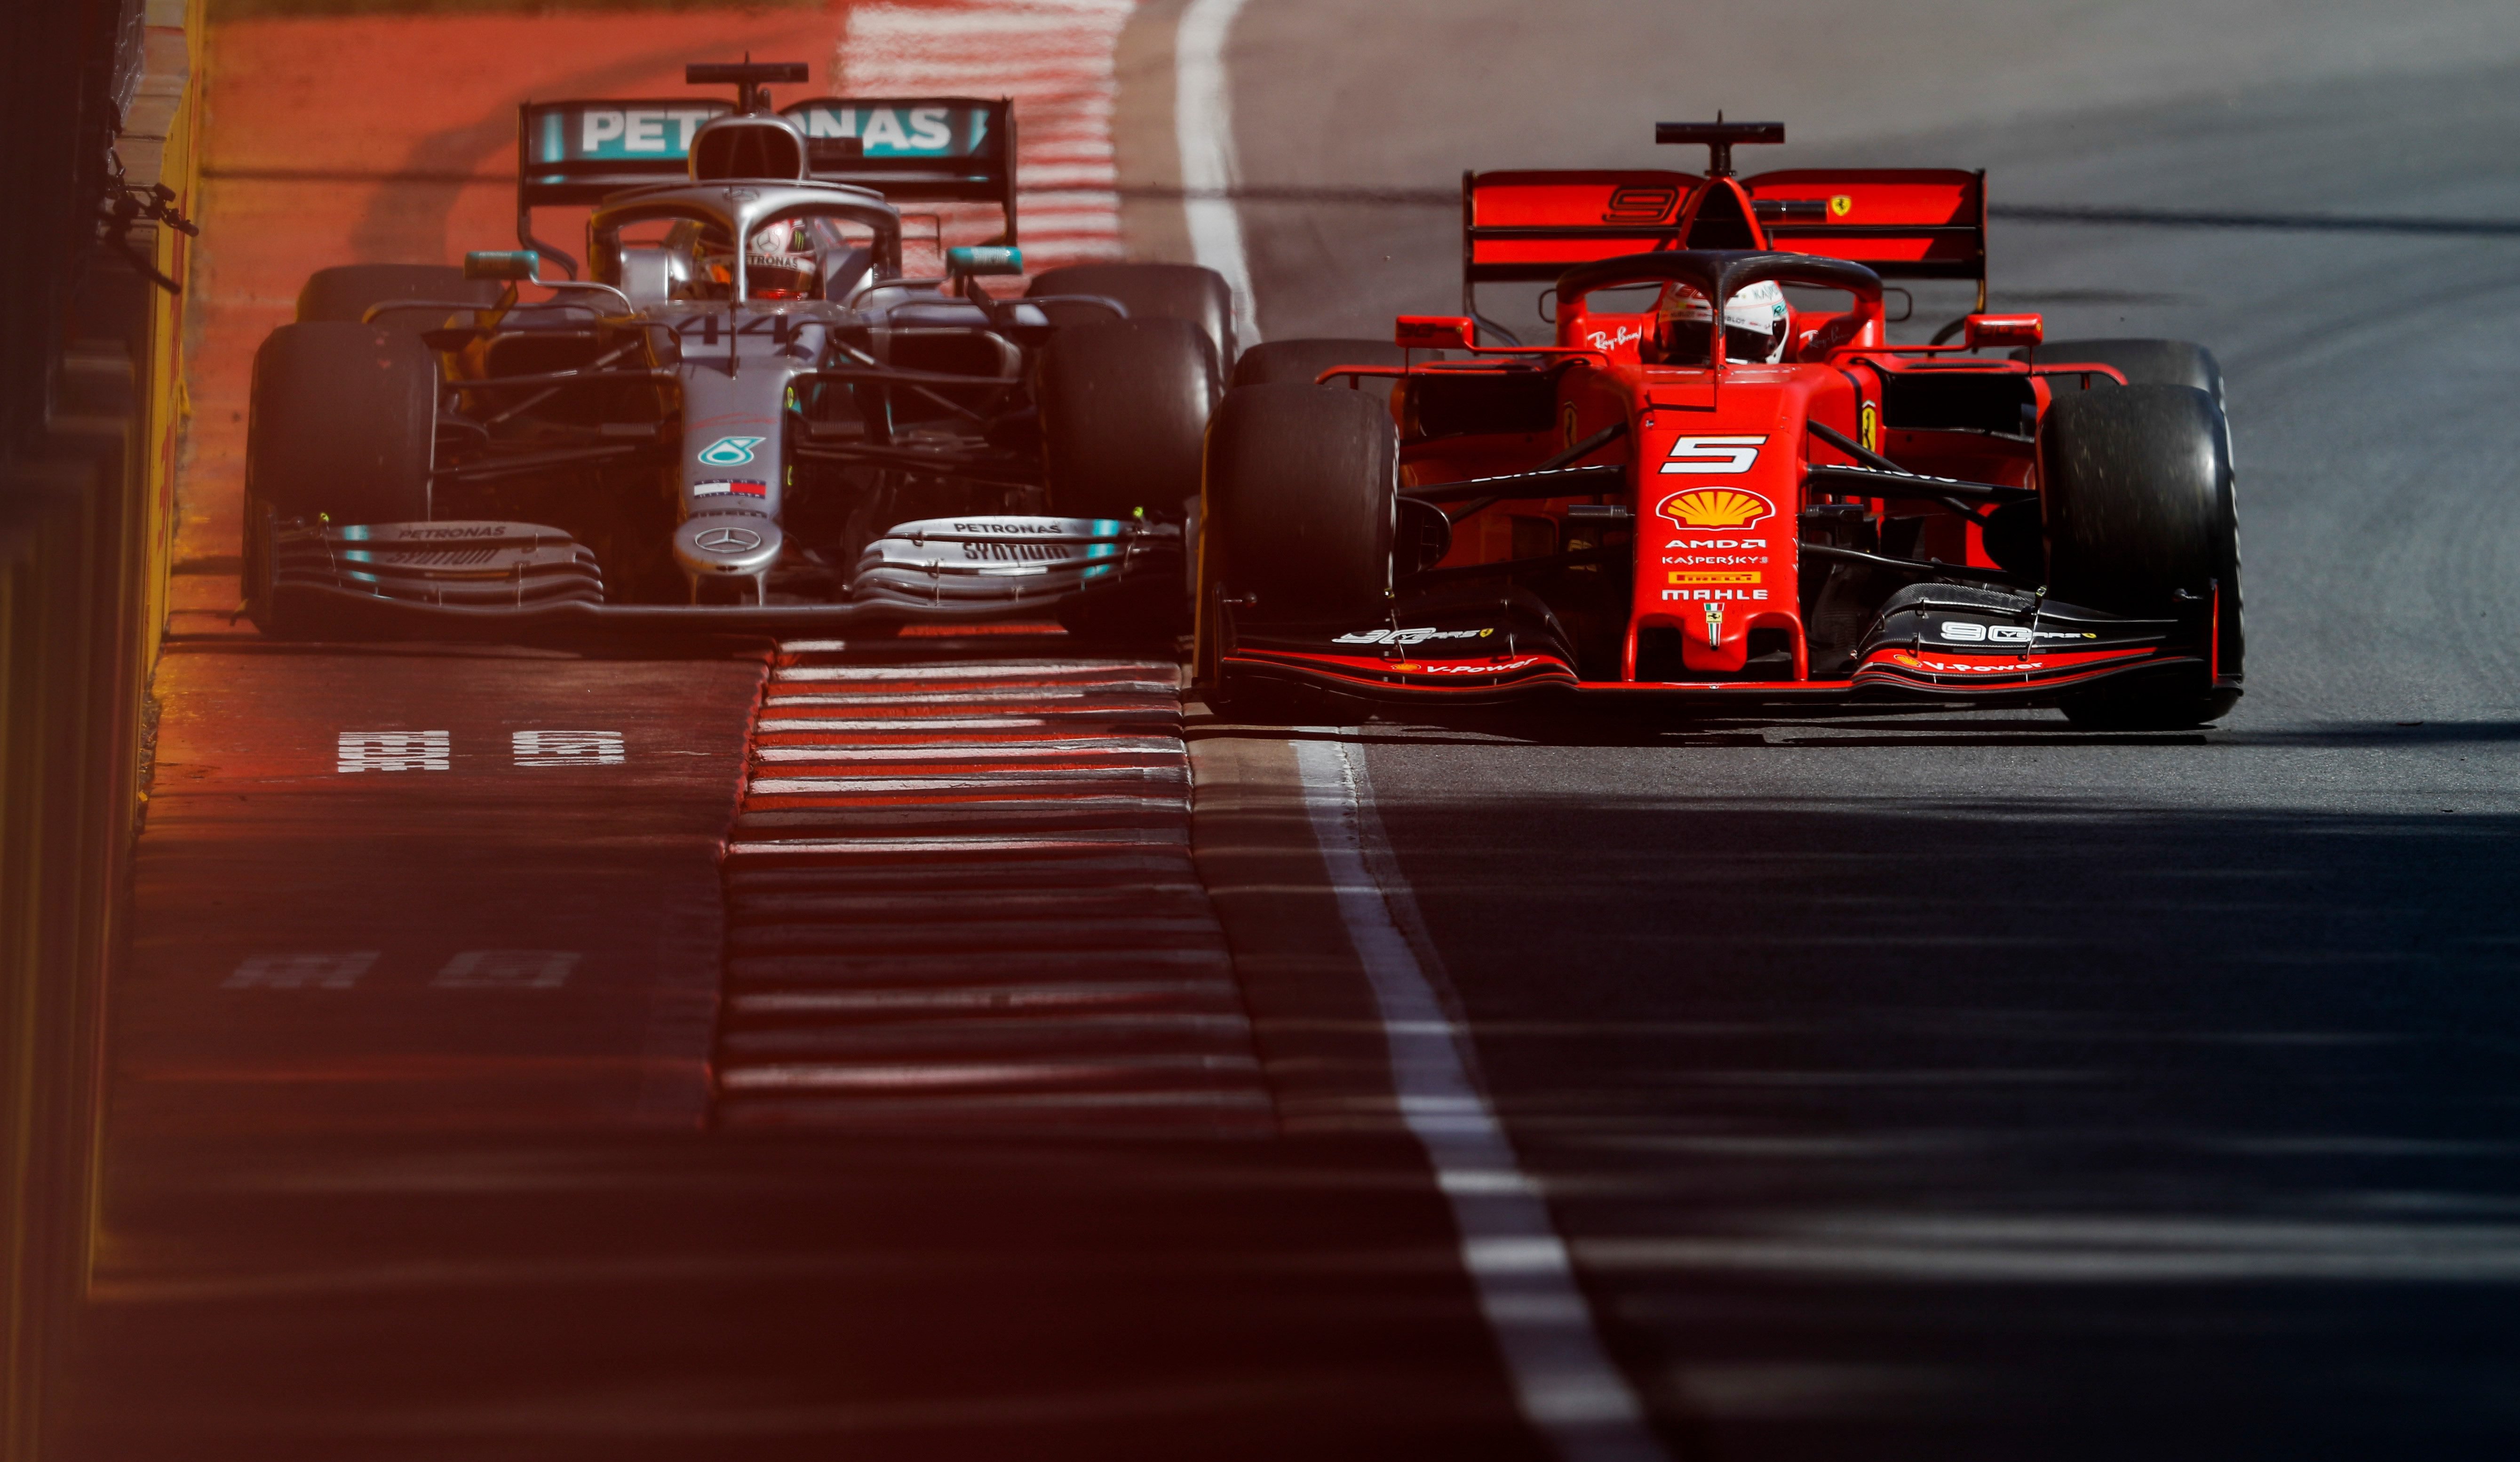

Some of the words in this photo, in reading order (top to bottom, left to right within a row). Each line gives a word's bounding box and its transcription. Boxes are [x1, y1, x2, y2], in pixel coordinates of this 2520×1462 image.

[582, 107, 952, 152] PETNAS
[747, 256, 798, 269] TRONAS
[676, 314, 789, 345] 44
[1658, 434, 1770, 474] 5
[398, 526, 507, 539] PETRONAS
[954, 523, 1062, 534] PETRONAS
[1664, 539, 1739, 549] AMD
[1661, 555, 1759, 566] KASPERSKY
[1661, 589, 1769, 601] MAHLE
[1940, 621, 2034, 642] 90
[1427, 657, 1539, 673] V-Power
[1922, 660, 2043, 672] V-Power
